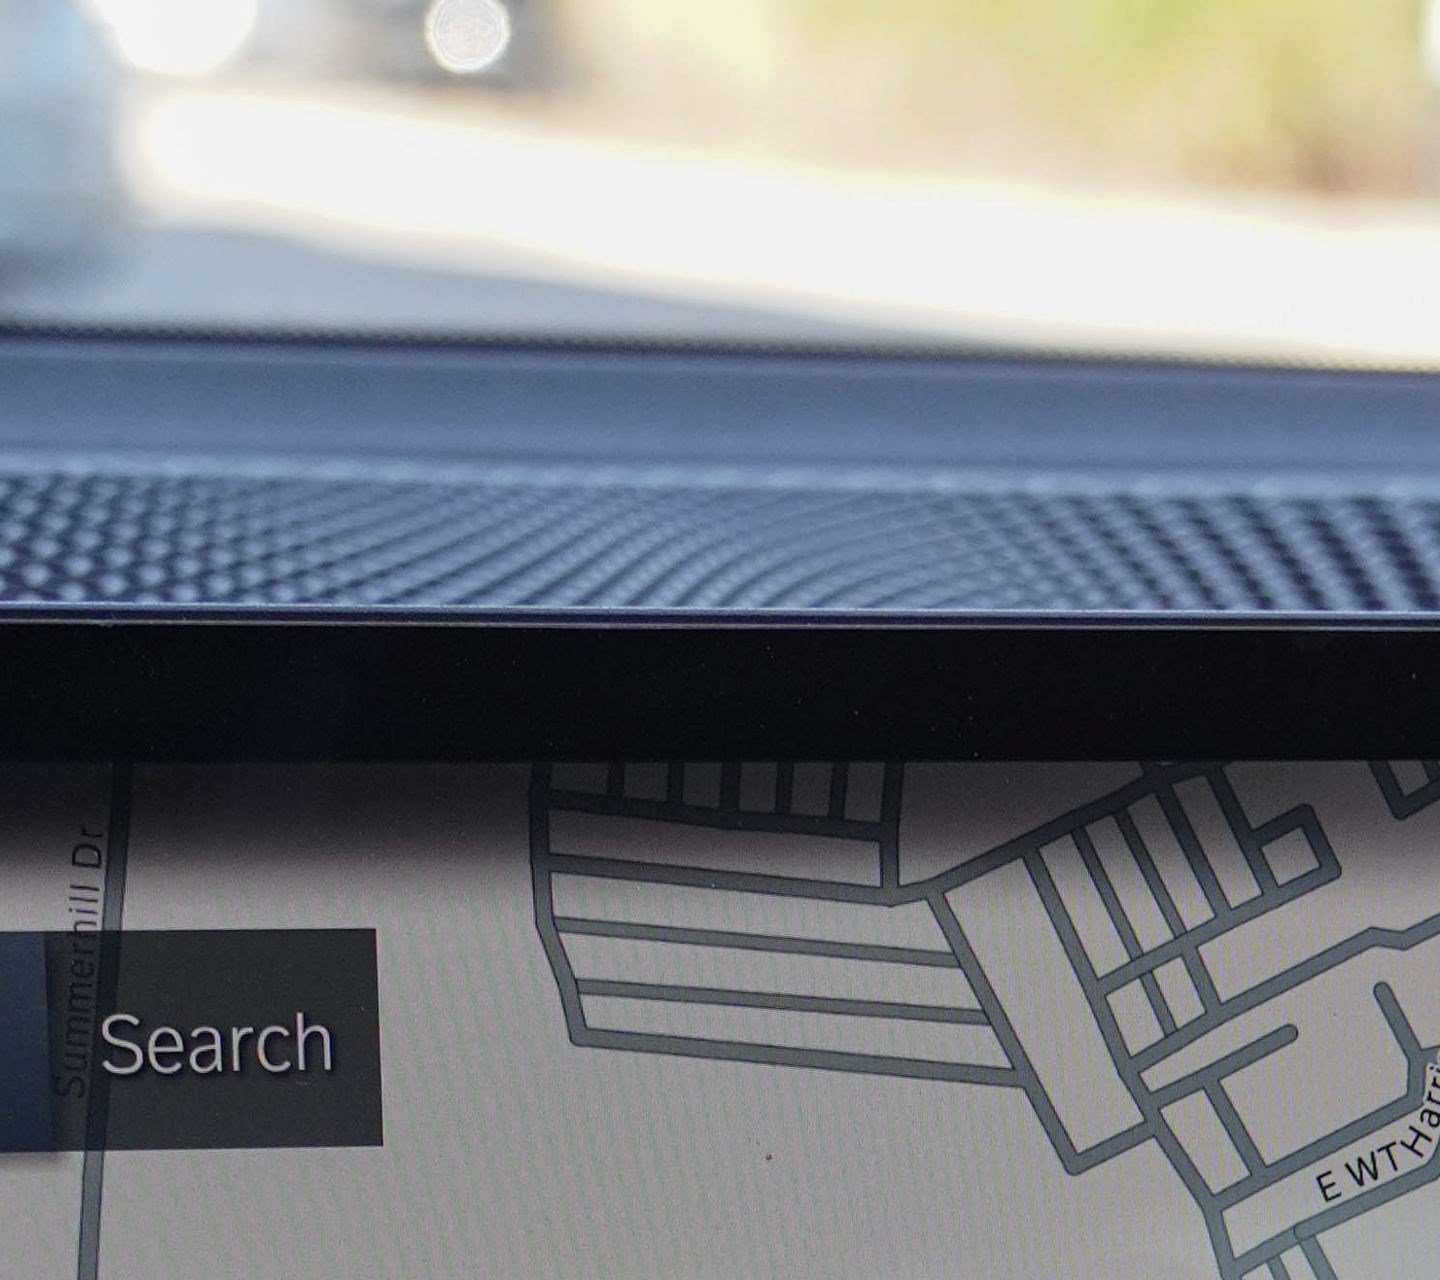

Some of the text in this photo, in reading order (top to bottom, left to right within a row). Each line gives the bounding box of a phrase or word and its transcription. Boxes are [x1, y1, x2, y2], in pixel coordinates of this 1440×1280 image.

[71, 824, 106, 871] Dr
[101, 1012, 333, 1076] Search
[1317, 1171, 1341, 1203] E
[1345, 1143, 1402, 1189] WT
